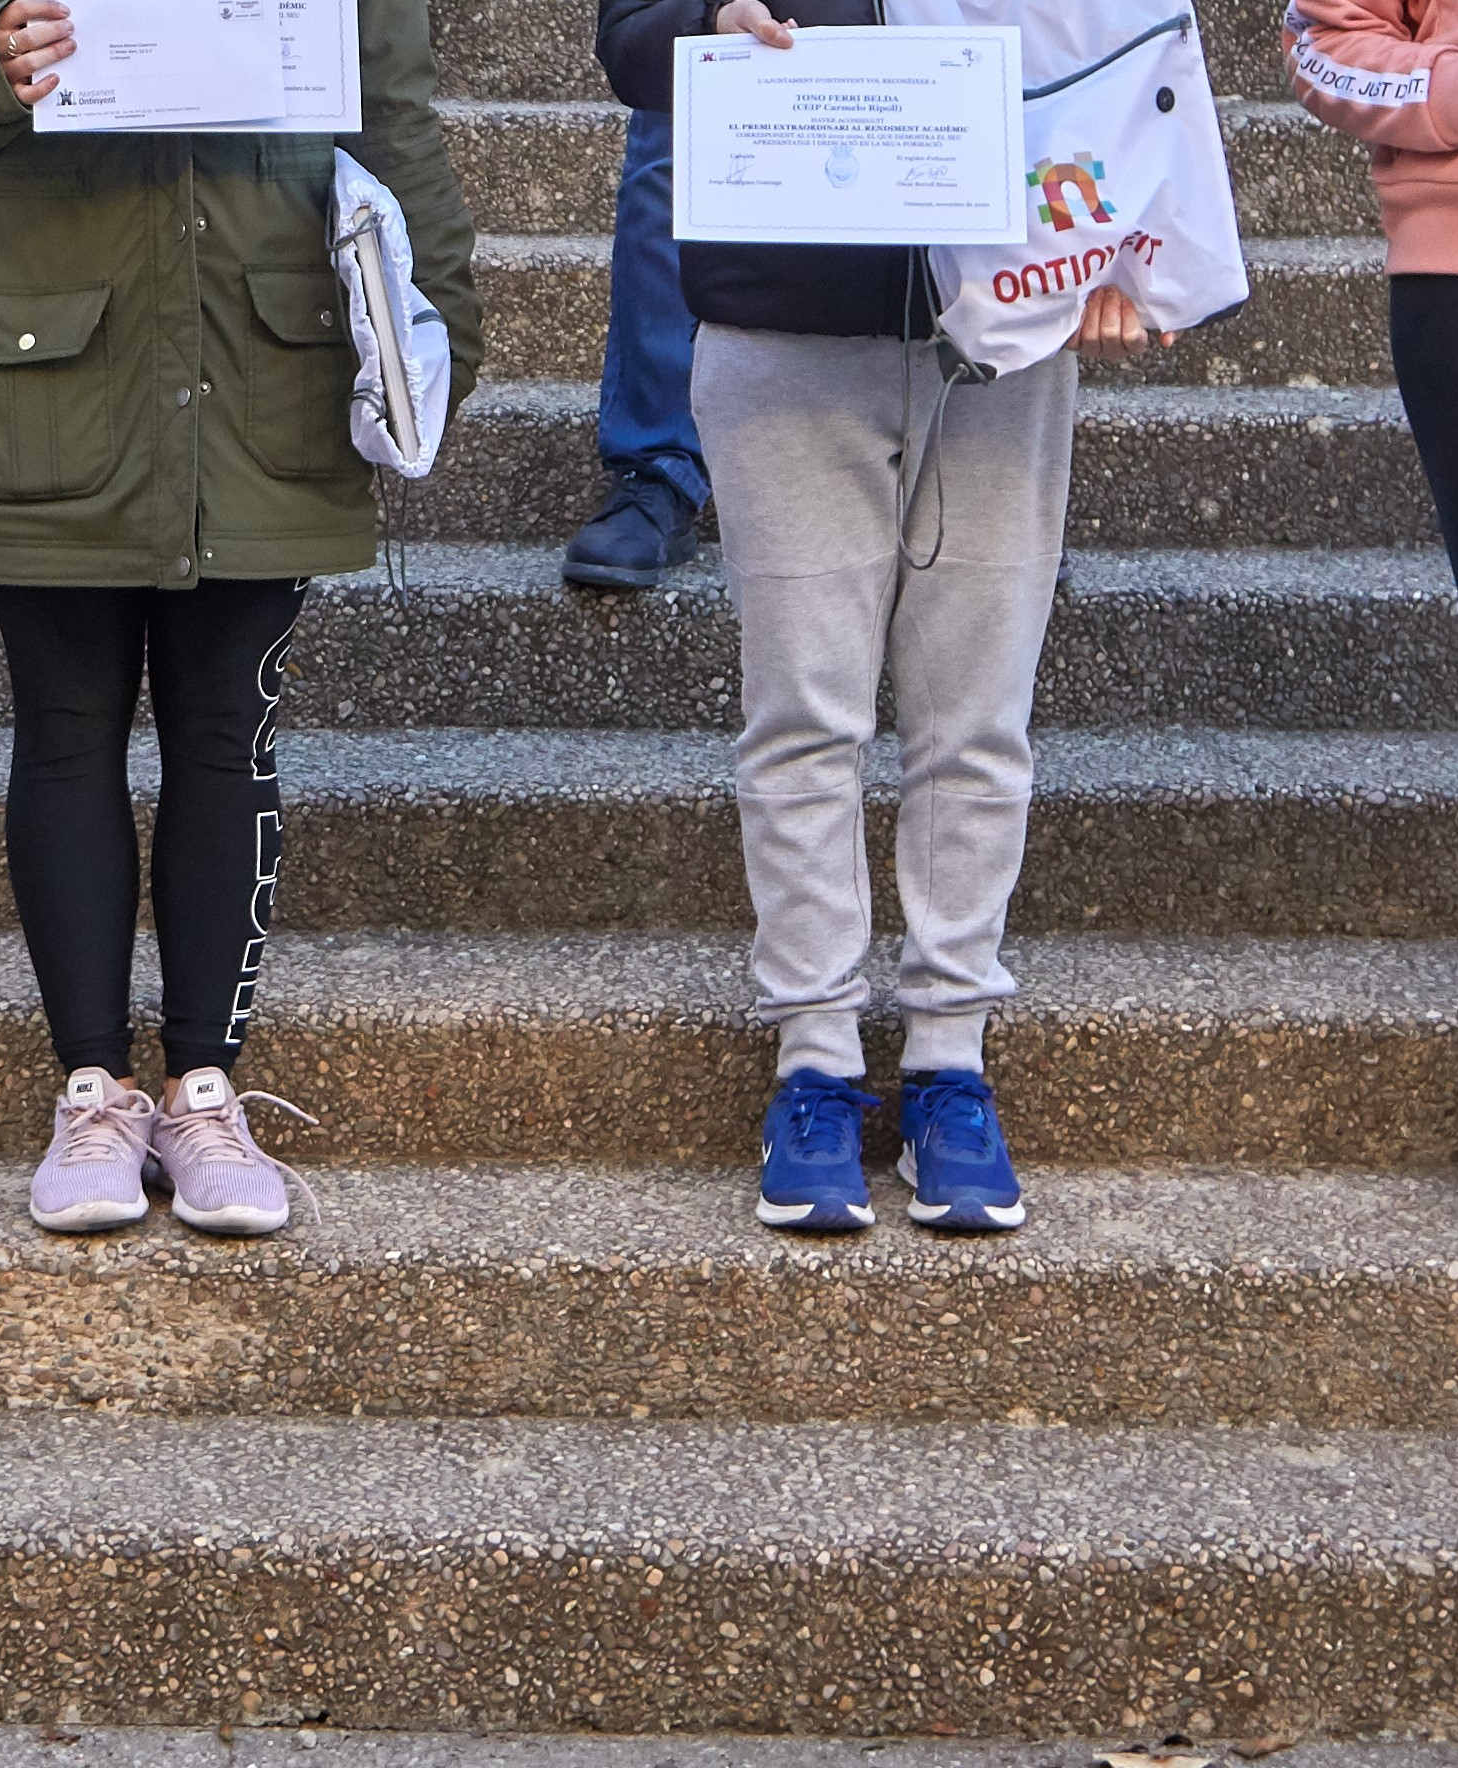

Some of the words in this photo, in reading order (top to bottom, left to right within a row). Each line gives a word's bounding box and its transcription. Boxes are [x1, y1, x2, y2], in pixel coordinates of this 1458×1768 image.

[78, 96, 116, 106] Ontinyent
[792, 103, 821, 111] (CEIP
[823, 103, 866, 112] Carmelo
[869, 104, 902, 112] Ripoll)
